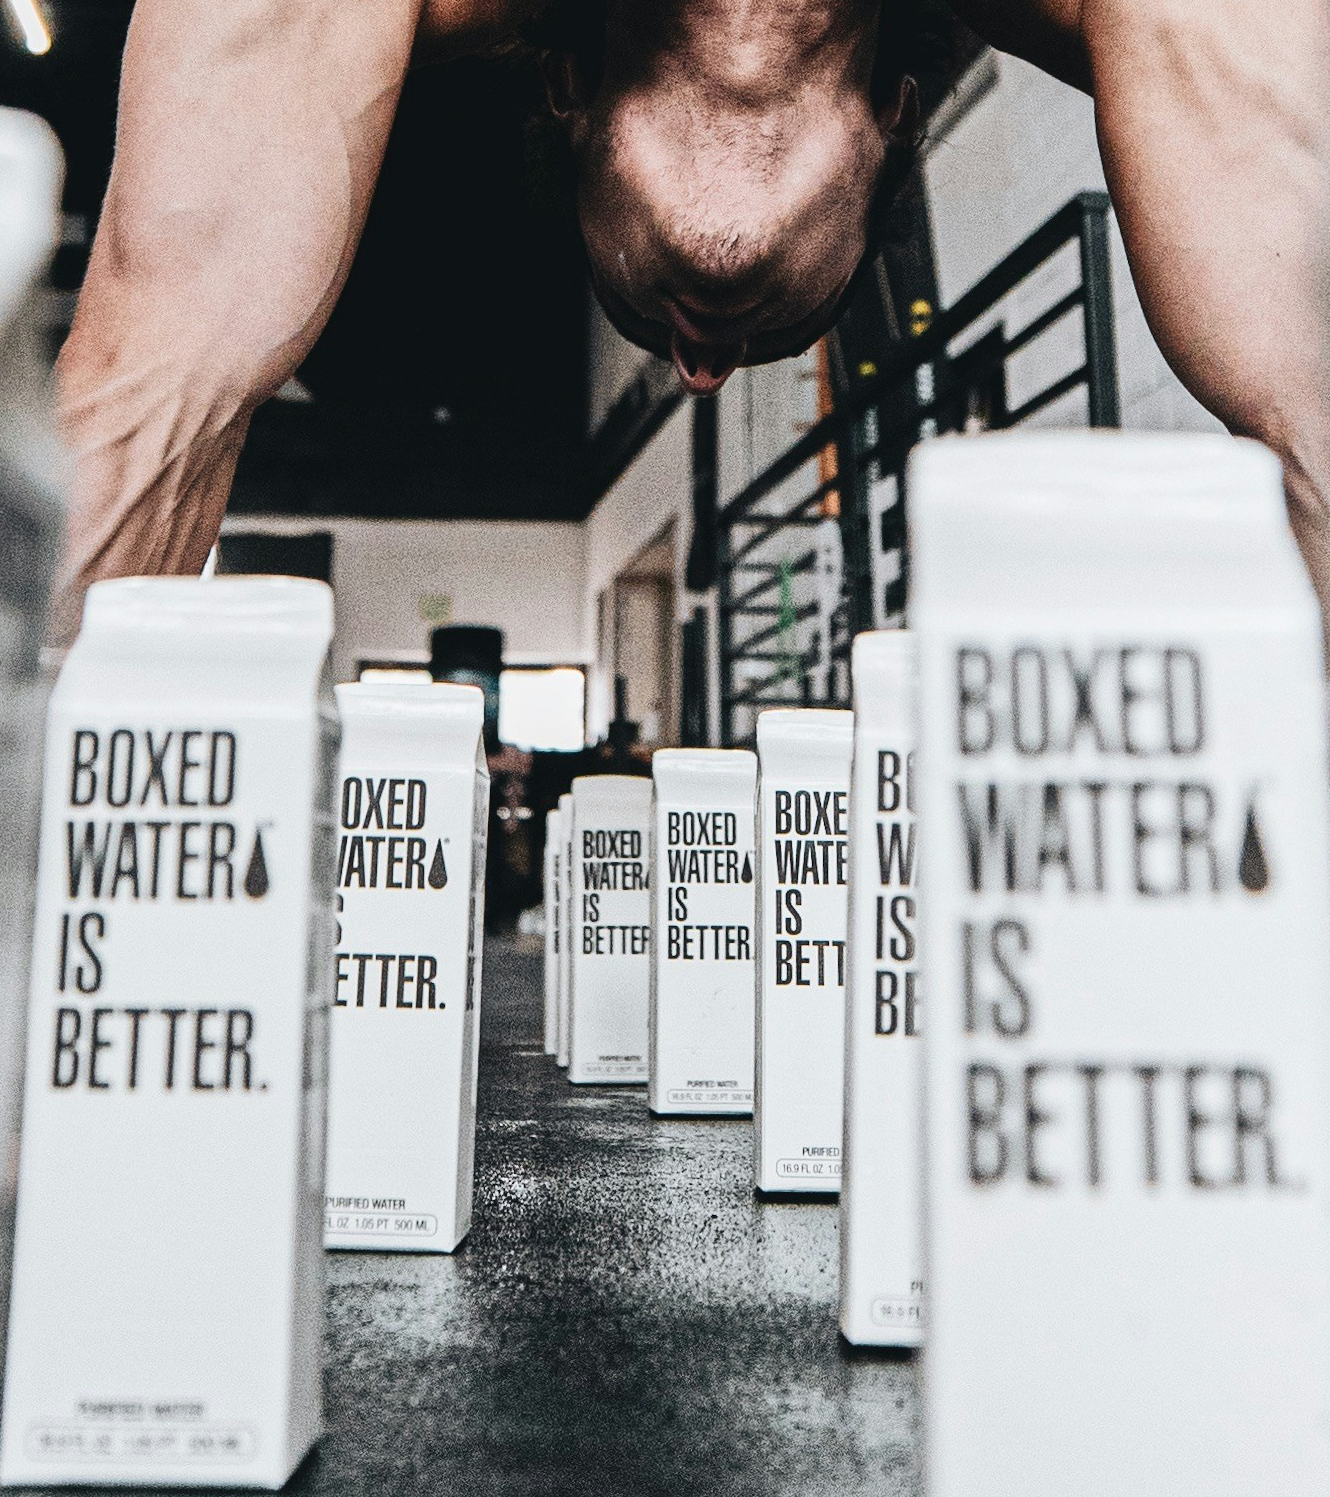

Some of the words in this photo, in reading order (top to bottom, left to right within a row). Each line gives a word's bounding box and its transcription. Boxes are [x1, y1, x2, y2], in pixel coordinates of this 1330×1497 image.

[955, 645, 1206, 758] BOXED
[70, 729, 237, 807] BOXED
[340, 776, 427, 831] OXED
[775, 790, 847, 836] BOXE
[583, 830, 641, 859] BOXED
[668, 811, 737, 846] BOXED
[956, 779, 1225, 897] WATER
[66, 821, 237, 900] WATER
[583, 862, 643, 891] WATER
[668, 849, 739, 884] WATER
[775, 839, 847, 886] WATE
[583, 893, 600, 923] IS
[668, 886, 688, 922] IS
[775, 888, 802, 936] IS
[58, 912, 106, 994] IS
[775, 939, 845, 987] BETT
[334, 952, 446, 1010] ETTER.
[959, 917, 1033, 1039] IS
[52, 1008, 268, 1091] BETTER.
[965, 1059, 1306, 1193] BETTER.
[783, 1163, 799, 1174] 16.9
[829, 1164, 841, 1174] 1.0
[802, 1147, 840, 1157] PURIFIED
[372, 1198, 406, 1211] WATER
